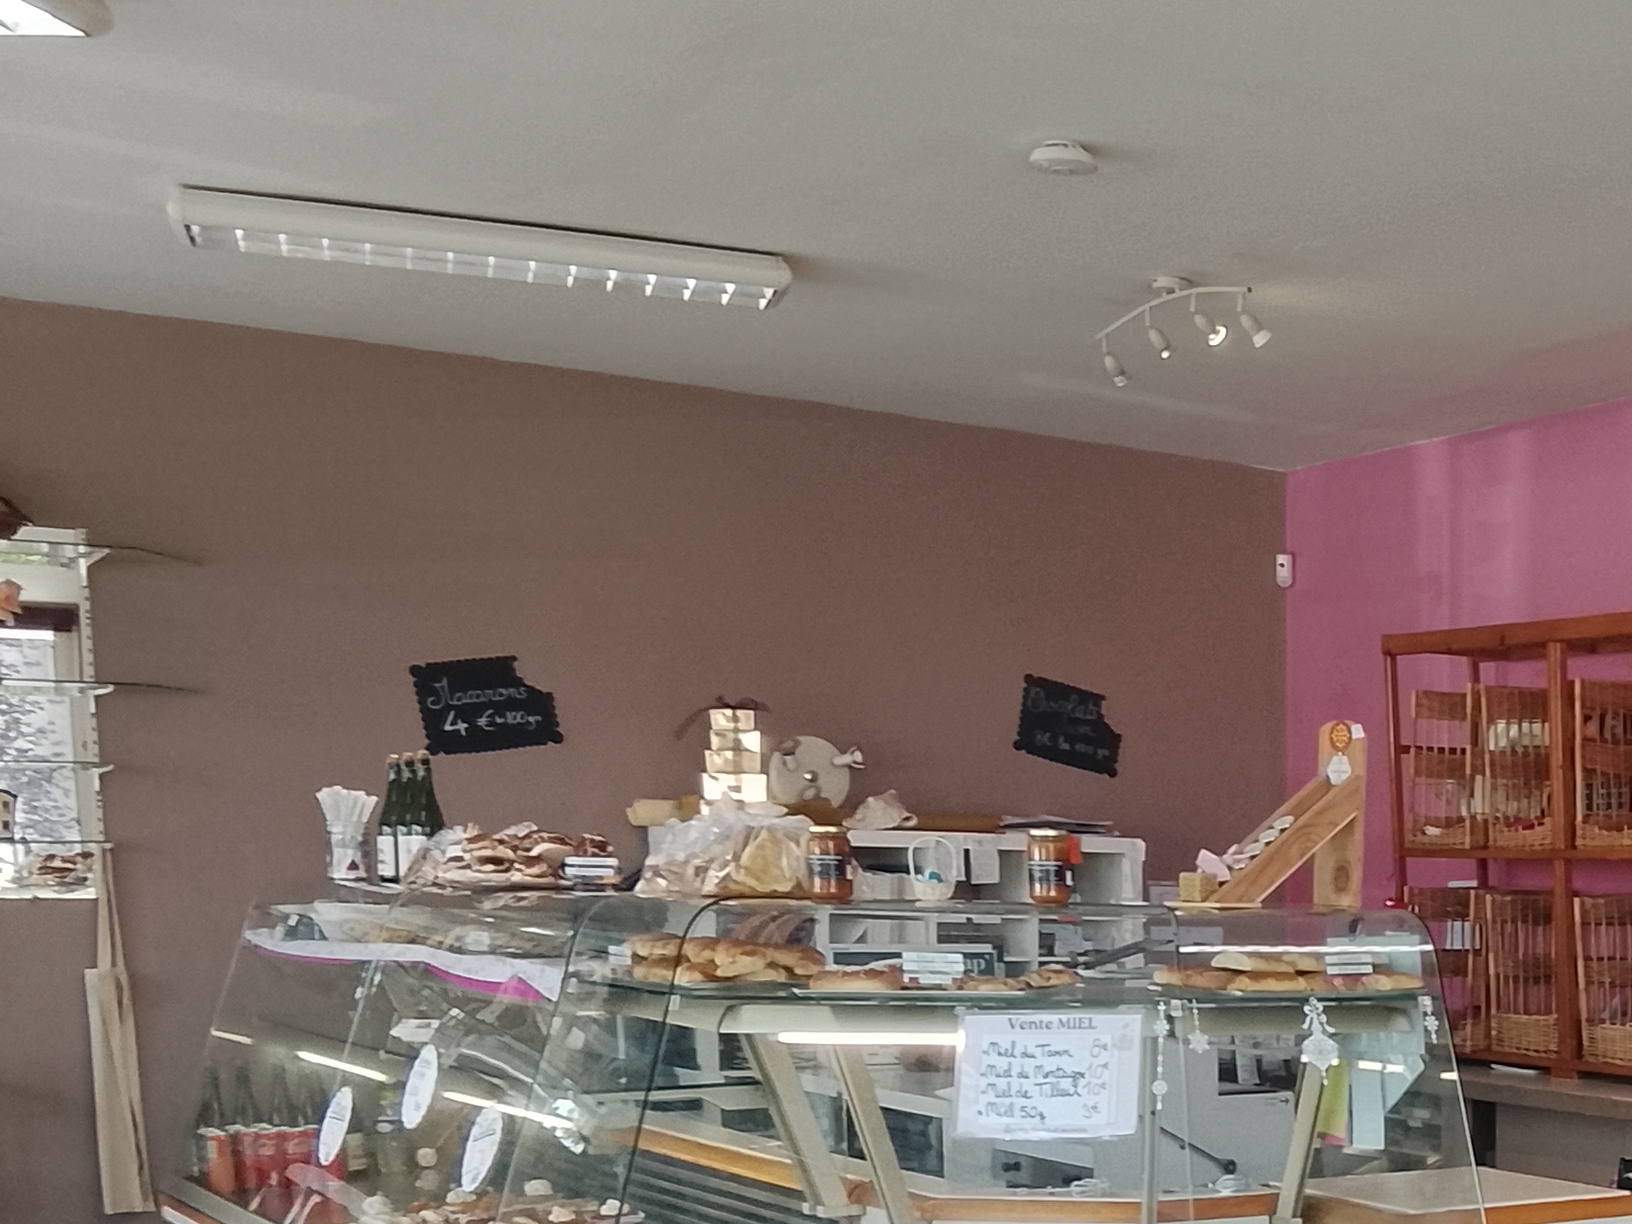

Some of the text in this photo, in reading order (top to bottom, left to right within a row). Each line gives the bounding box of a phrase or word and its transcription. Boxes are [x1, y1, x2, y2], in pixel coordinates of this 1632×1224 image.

[426, 676, 529, 710] Macarons
[443, 710, 469, 737] 4
[1007, 1017, 1098, 1030] Vente MIEL
